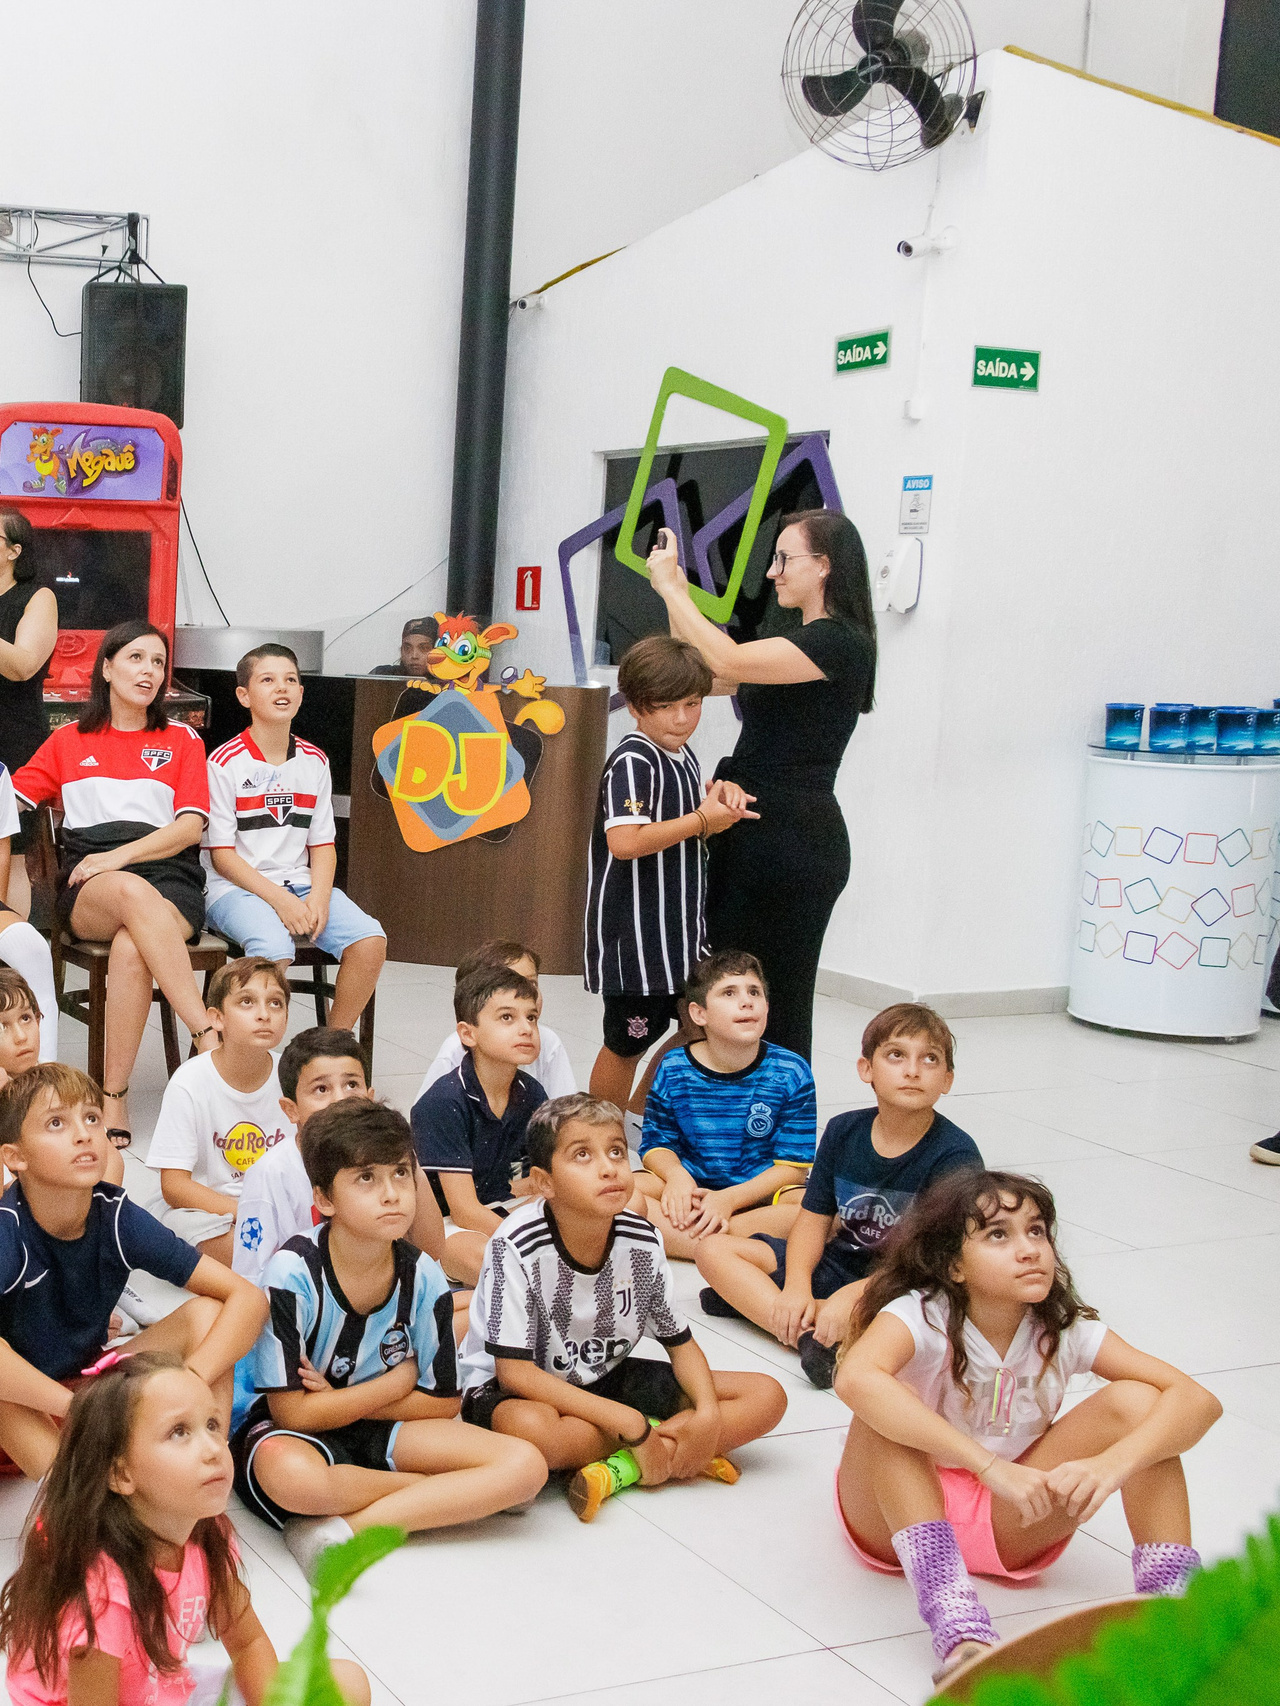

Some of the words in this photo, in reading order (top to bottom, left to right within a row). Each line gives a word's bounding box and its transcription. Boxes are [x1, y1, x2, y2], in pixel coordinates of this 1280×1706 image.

[837, 344, 872, 365] SAÍDA
[976, 358, 1018, 379] SAÍDA
[906, 479, 930, 489] AVISO
[142, 749, 171, 759] SPFC
[392, 720, 507, 816] DJ
[267, 796, 292, 806] SPFC
[236, 1157, 255, 1166] CAFE
[837, 1204, 870, 1221] ard
[872, 1204, 901, 1230] Ro
[860, 1226, 882, 1239] CAFE
